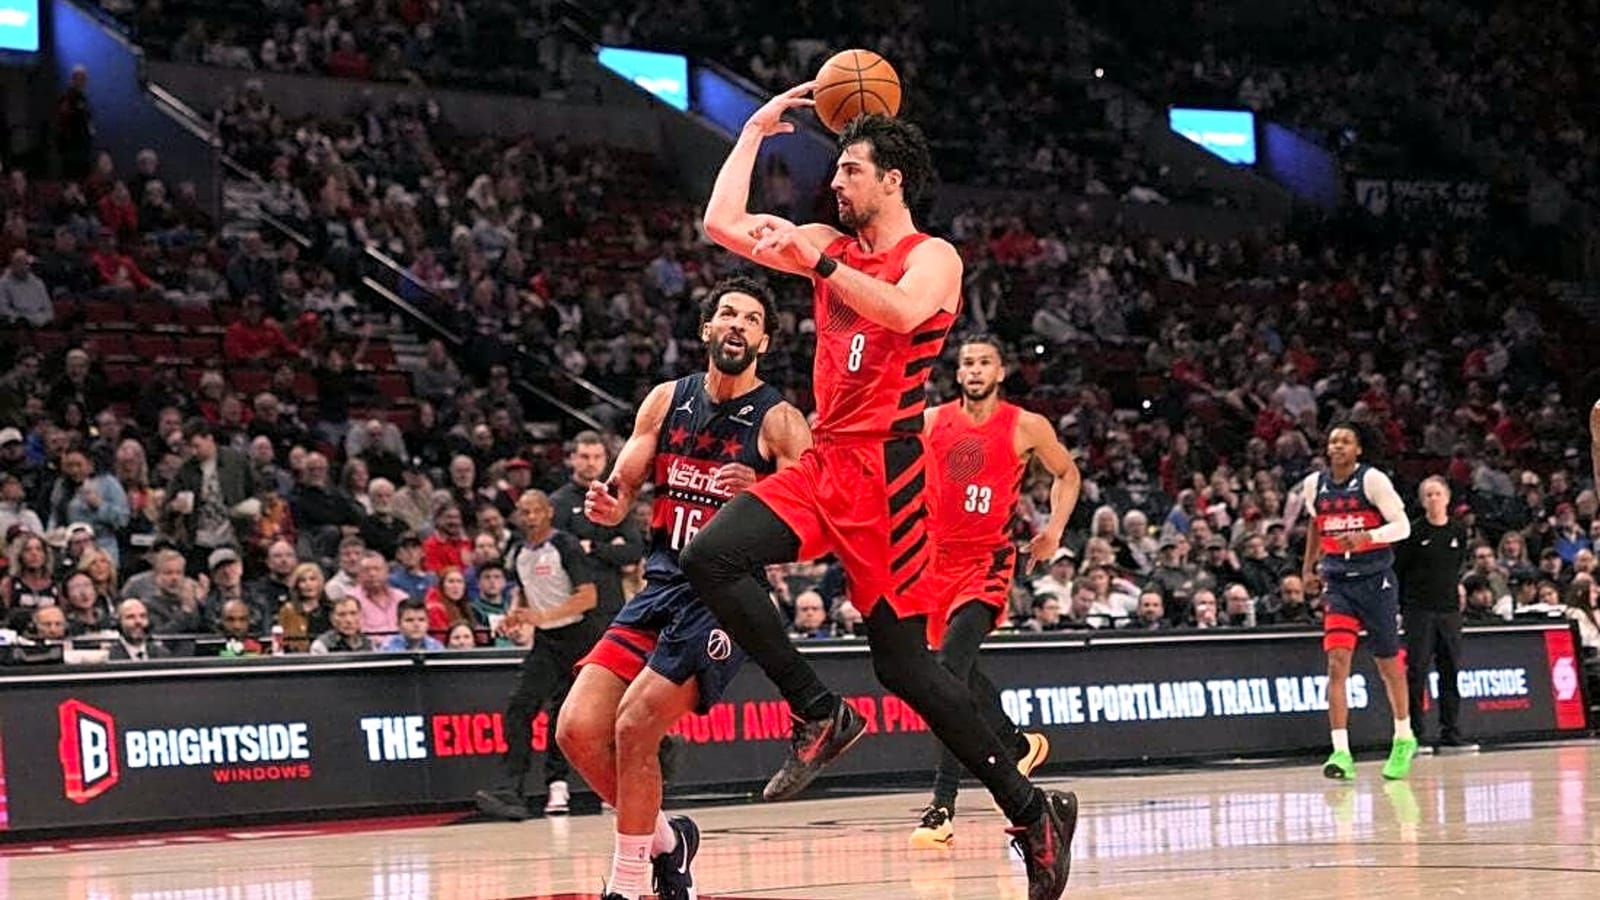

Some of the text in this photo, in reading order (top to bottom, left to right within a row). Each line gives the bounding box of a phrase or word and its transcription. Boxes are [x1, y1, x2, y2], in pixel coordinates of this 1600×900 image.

[847, 333, 865, 372] 8
[964, 484, 992, 514] 33
[671, 506, 702, 551] 16
[1000, 673, 1368, 727] OF THE PORTLAND TRAIL BLAZS
[1429, 668, 1528, 699] GHTSIDE
[80, 718, 109, 783] B
[125, 722, 310, 768] BRIGHTSIDE
[361, 716, 427, 761] THE
[213, 764, 312, 783] WINDOWS
